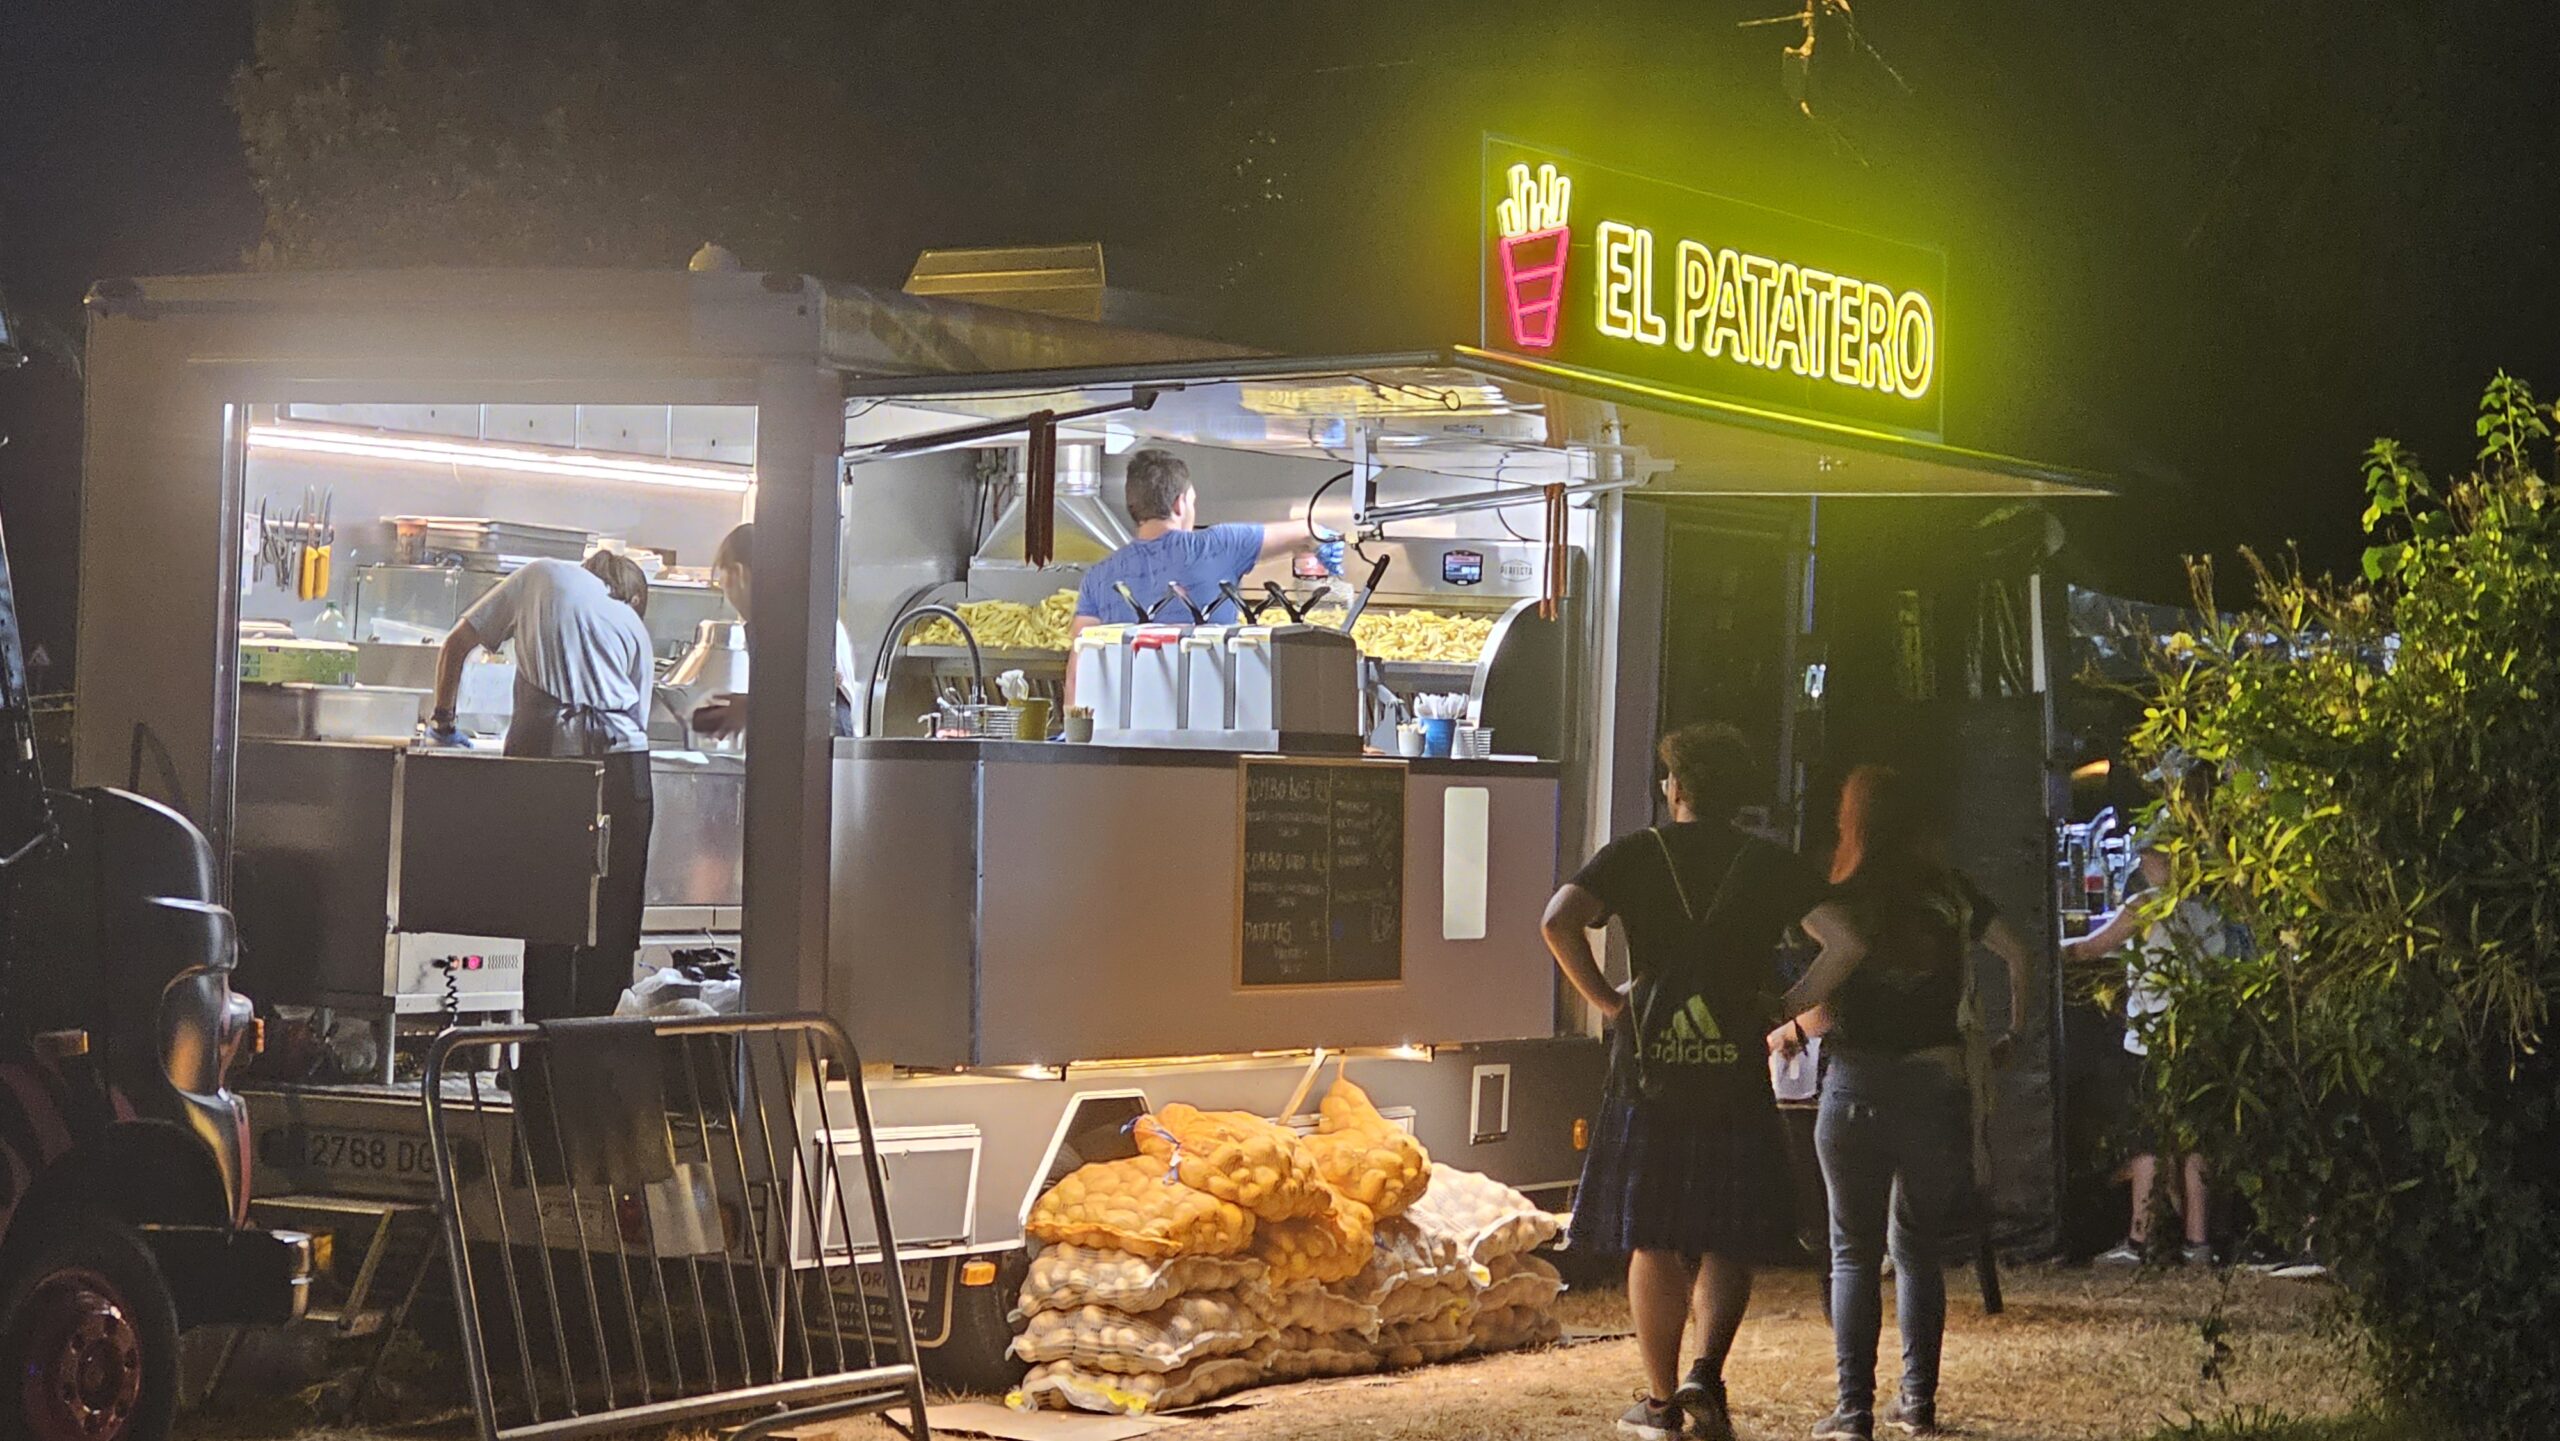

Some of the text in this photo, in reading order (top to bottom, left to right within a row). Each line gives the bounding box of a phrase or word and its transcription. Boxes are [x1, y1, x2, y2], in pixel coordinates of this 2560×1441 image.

[1596, 220, 1934, 399] EL PATATERO
[312, 1134, 387, 1170] 2768
